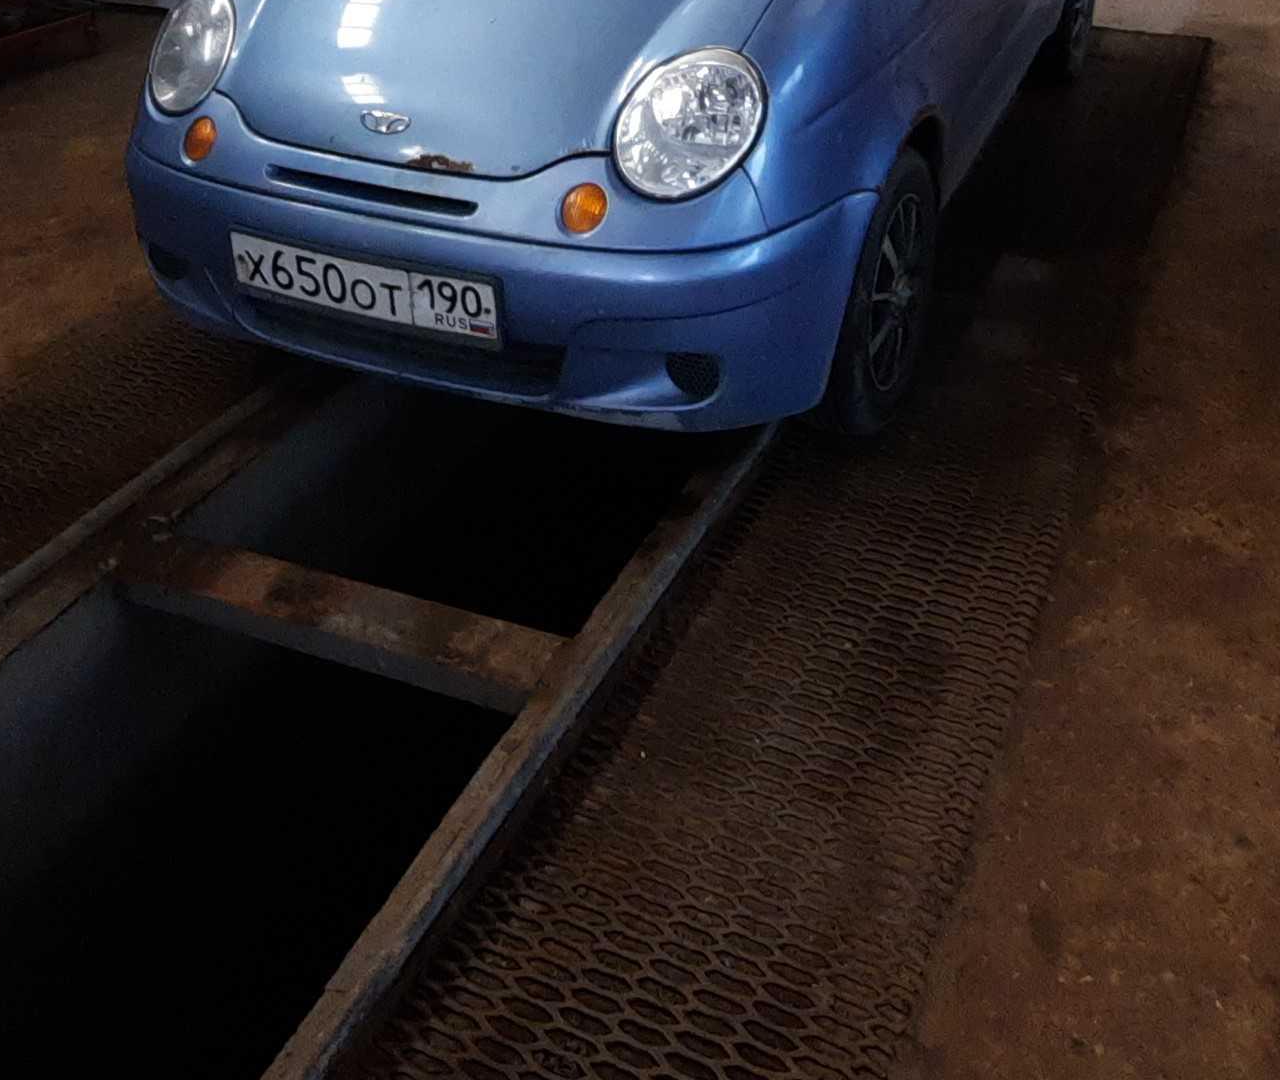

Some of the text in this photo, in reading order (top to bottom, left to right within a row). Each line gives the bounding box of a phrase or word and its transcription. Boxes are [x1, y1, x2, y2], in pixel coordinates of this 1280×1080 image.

[245, 250, 482, 318] Х650ОТ 190
[434, 313, 468, 331] RUS
